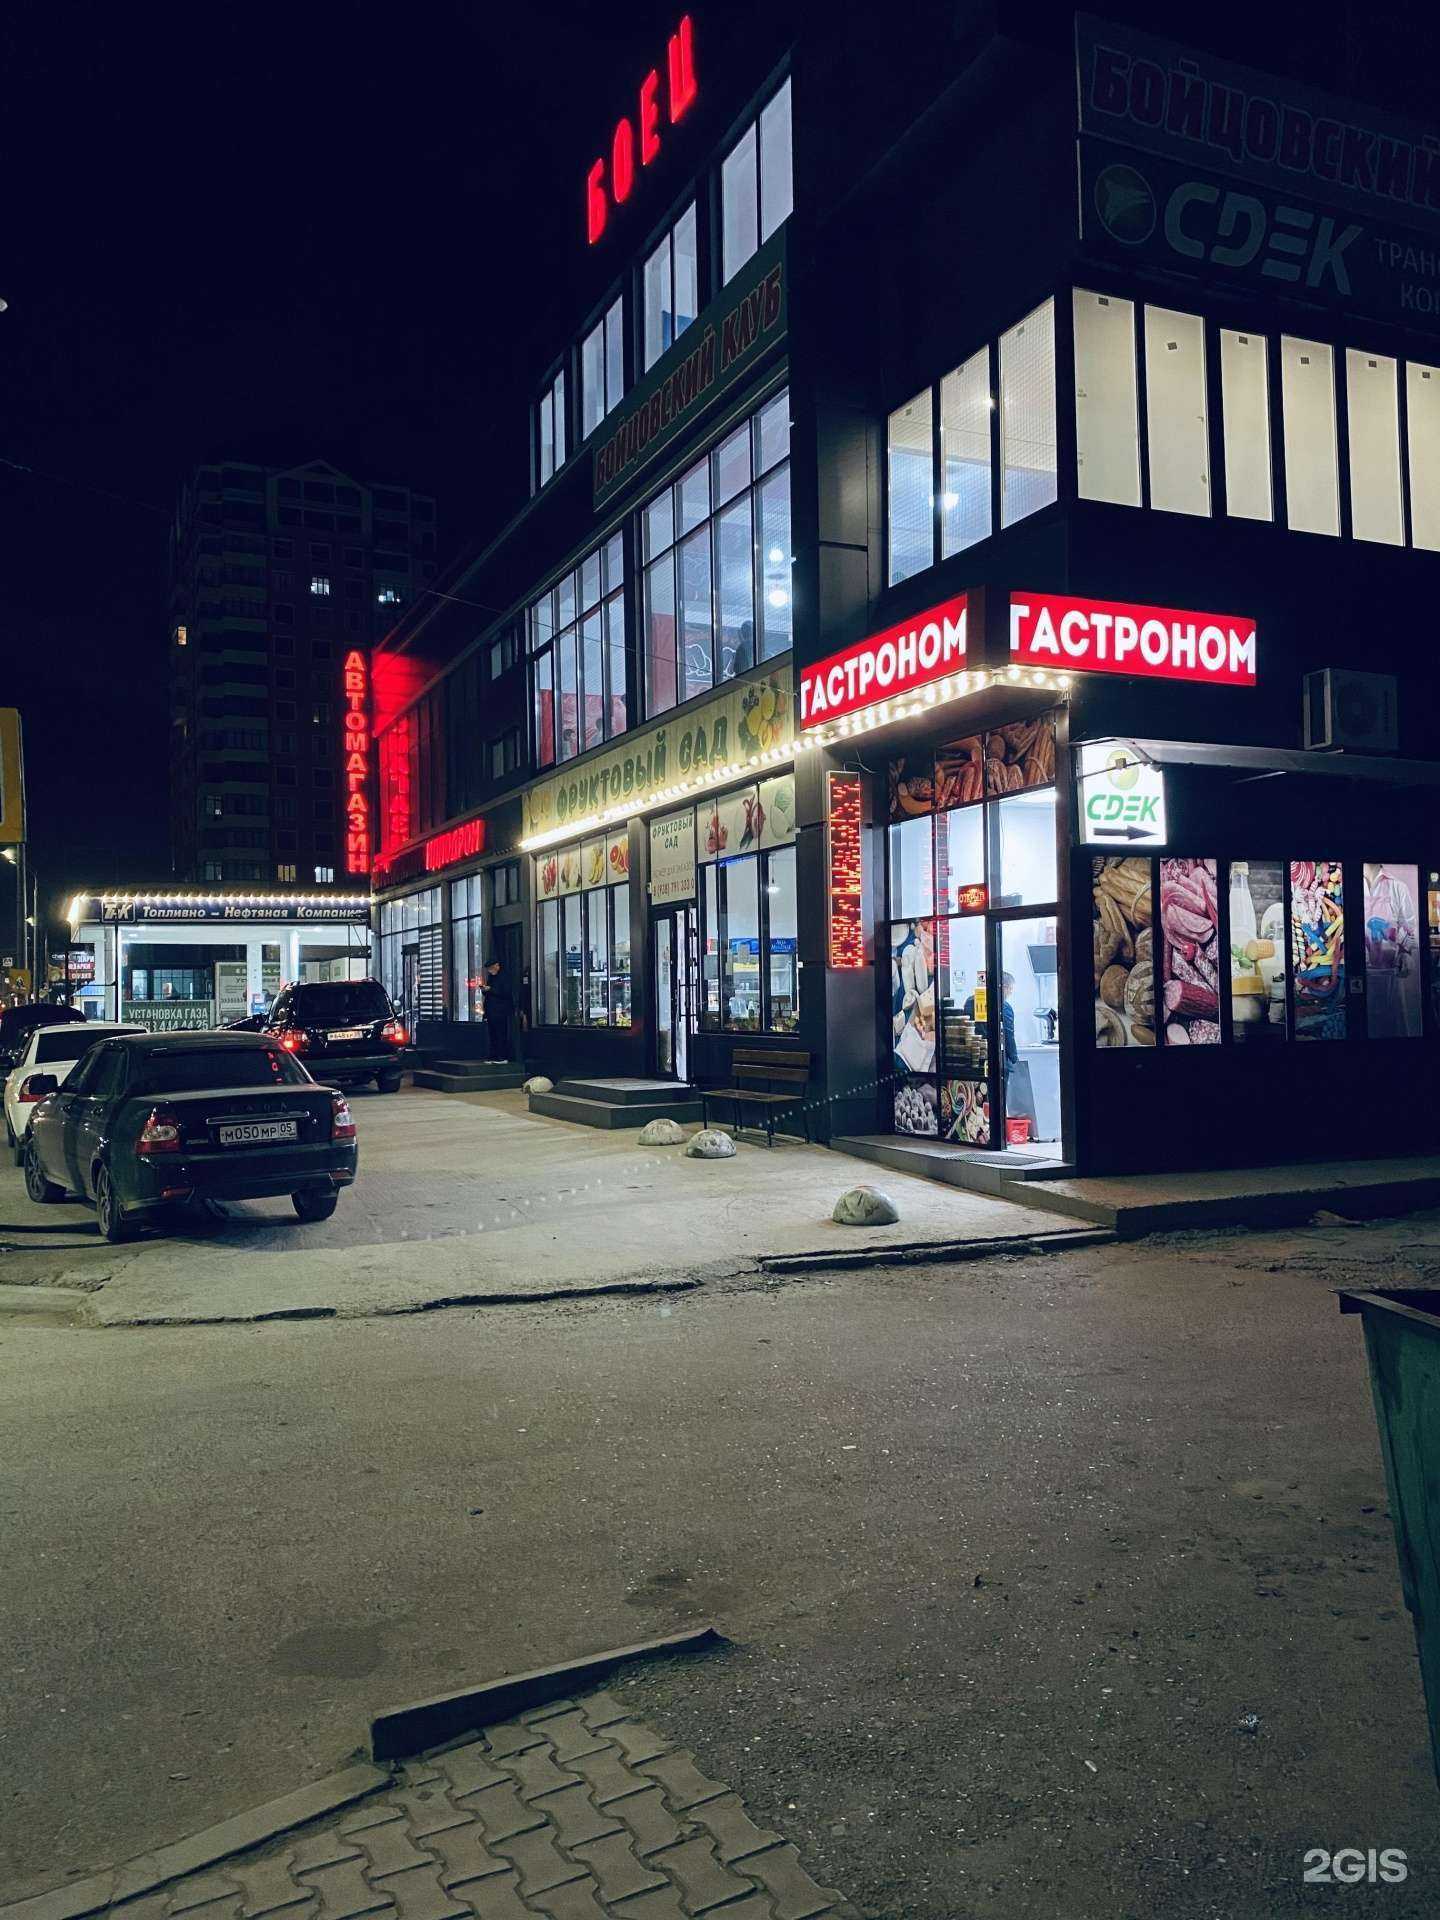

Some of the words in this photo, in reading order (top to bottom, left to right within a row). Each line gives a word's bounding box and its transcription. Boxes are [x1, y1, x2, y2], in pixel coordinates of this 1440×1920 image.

[585, 13, 699, 247] БОЕЦ
[1163, 180, 1365, 297] CDEK
[1375, 237, 1440, 278] ТРАН
[1401, 281, 1440, 316] КО
[593, 322, 717, 498] БОЙЦОВСКИЙ
[720, 261, 783, 374] КЛУБ
[1010, 603, 1256, 674] ГАСТРОНОМ
[801, 608, 968, 720] ГАСТРОНОМ
[344, 651, 370, 873] АВТОМАГАЗИН
[556, 730, 667, 824] ФРУКТОВЫЙ
[678, 715, 729, 776] САД
[652, 812, 693, 840] ФРУКТОВЫЙ
[1086, 793, 1161, 822] CDEK
[664, 836, 679, 849] САД
[143, 906, 206, 918] Топливно
[224, 906, 288, 918] Нефтяная
[129, 1008, 183, 1020] УСТАНОВКА
[185, 1008, 208, 1019] ГАЗА
[280, 1122, 292, 1133] 05
